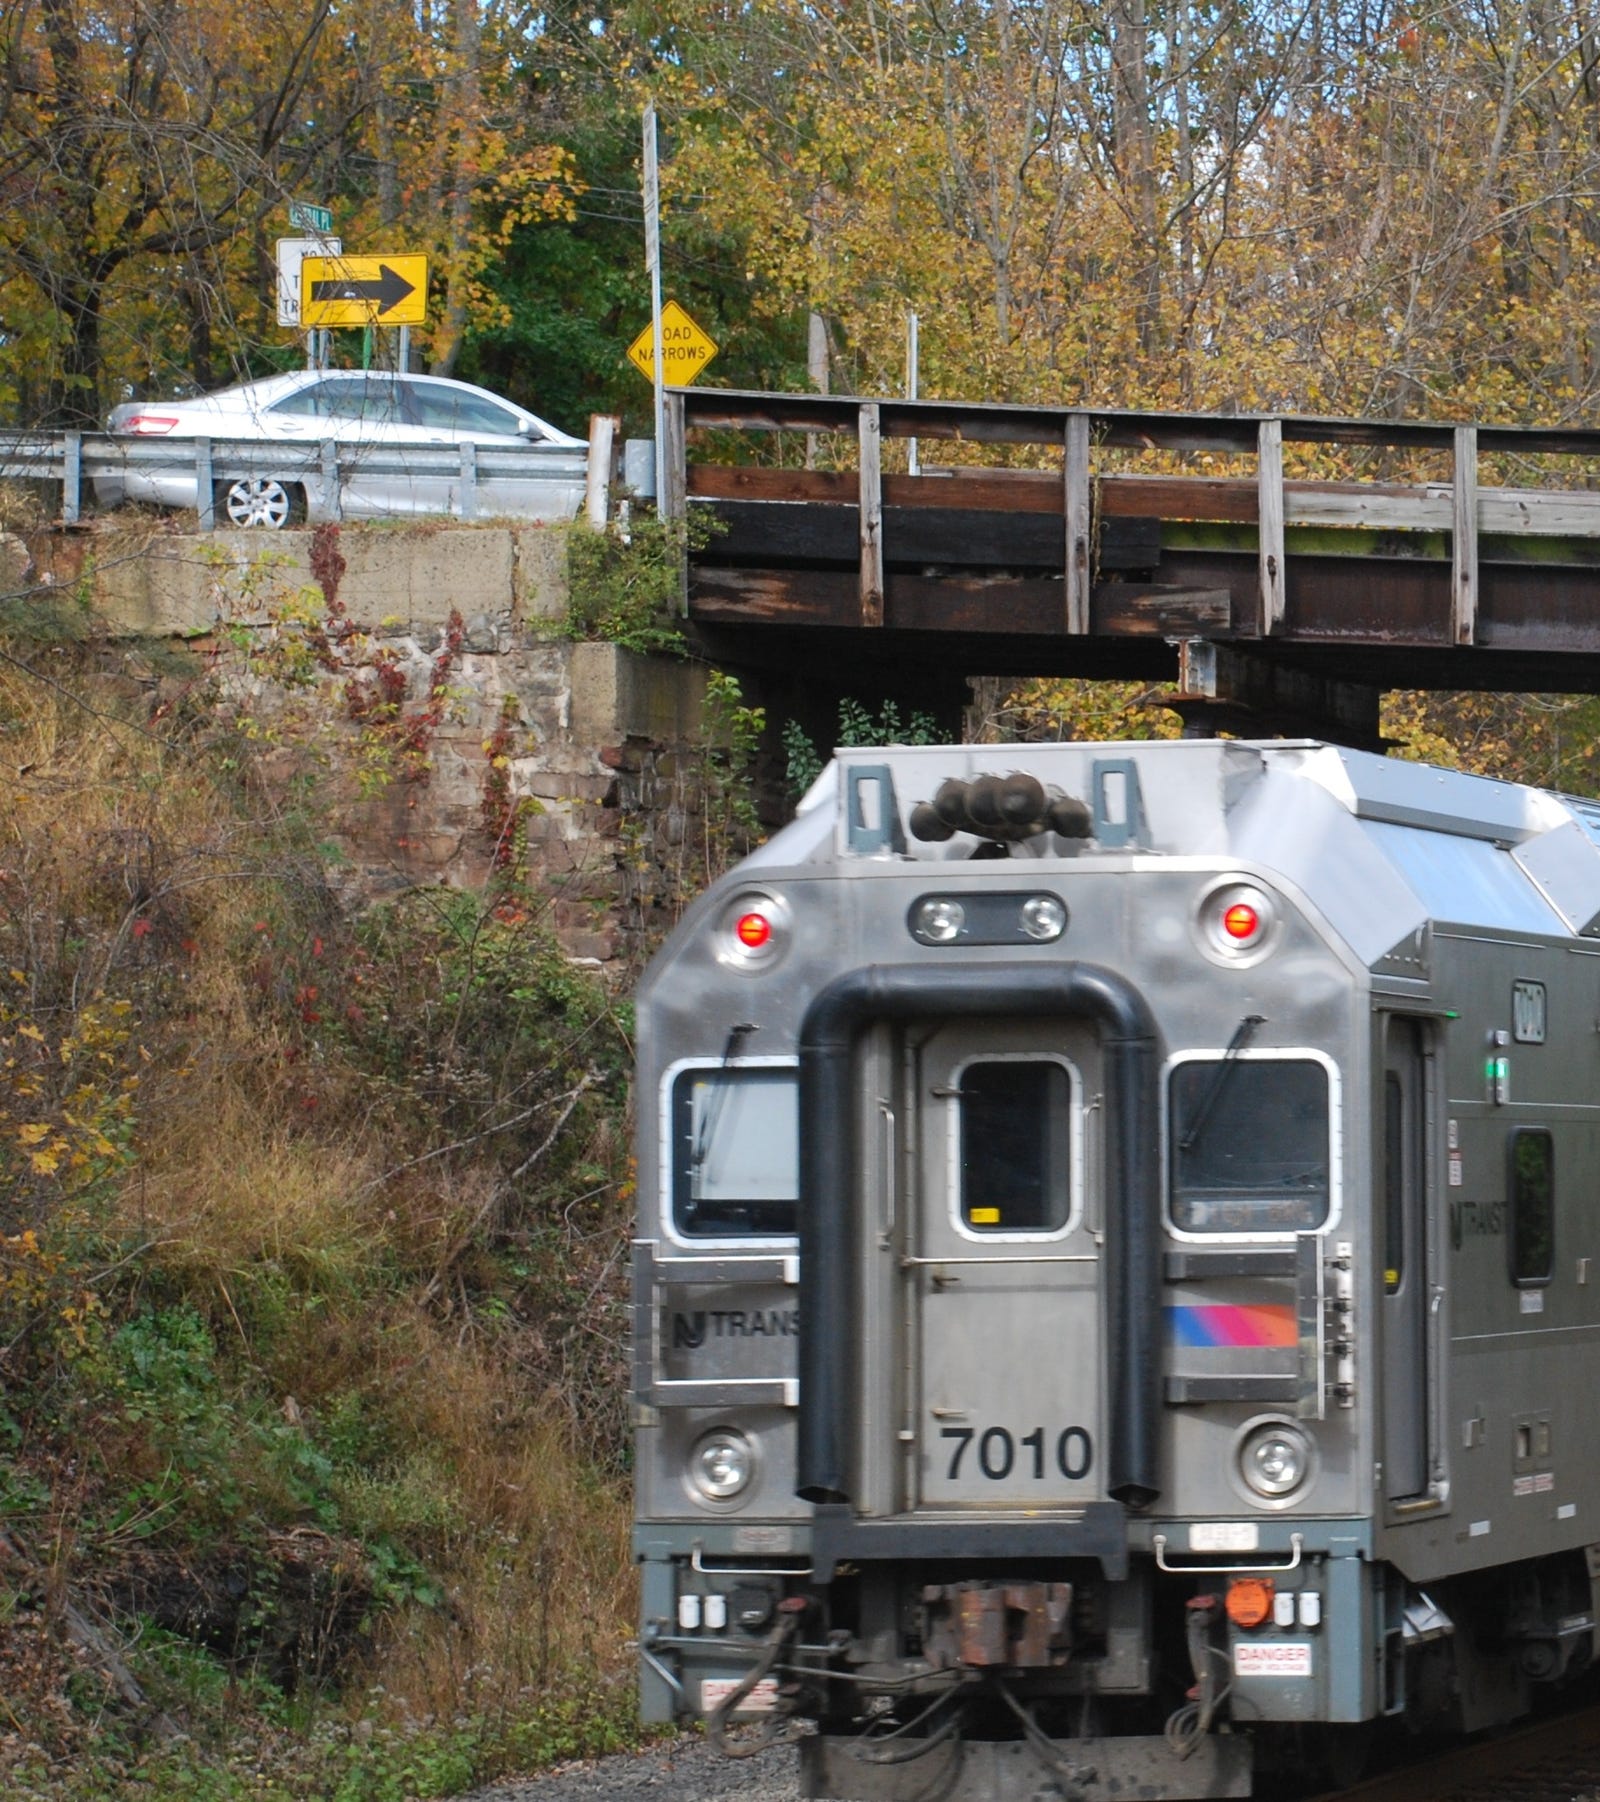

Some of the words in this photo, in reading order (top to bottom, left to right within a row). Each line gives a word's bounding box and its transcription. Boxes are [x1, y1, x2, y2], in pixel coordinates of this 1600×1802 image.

[663, 326, 692, 341] OAD
[940, 1425, 1093, 1480] 7010
[1239, 1647, 1306, 1661] DANGER
